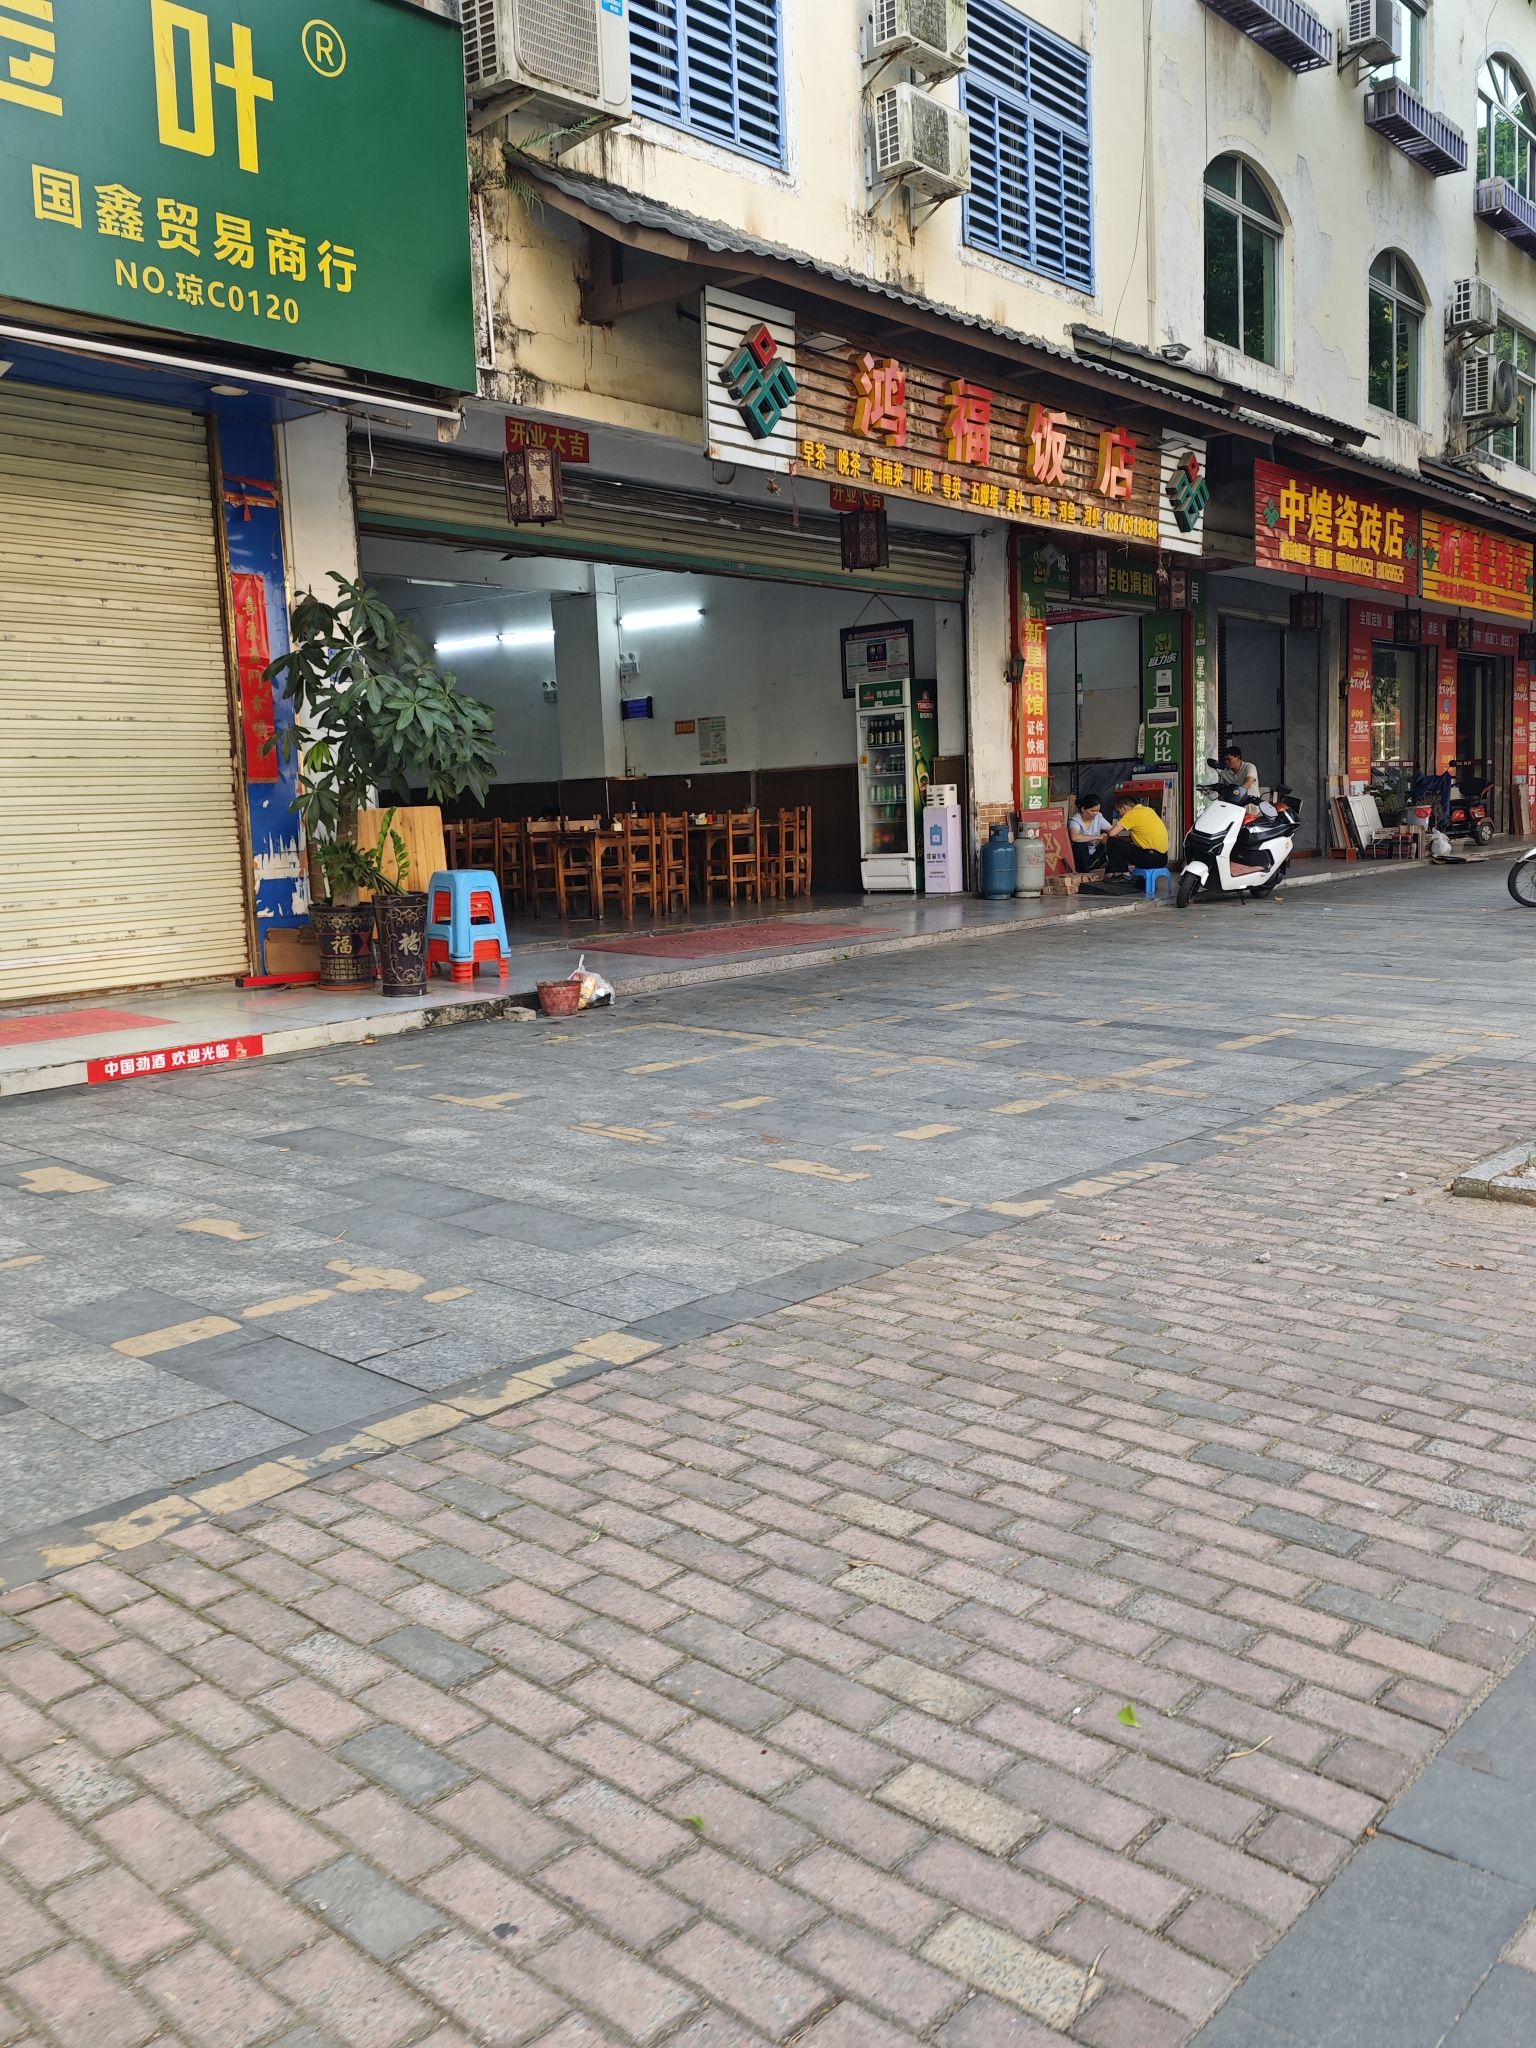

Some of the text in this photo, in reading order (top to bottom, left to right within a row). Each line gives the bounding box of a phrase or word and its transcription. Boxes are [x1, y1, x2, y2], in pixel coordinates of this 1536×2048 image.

[31, 164, 357, 293] 国鑫贸易商行
[114, 258, 300, 324] NO.琼C0120
[509, 420, 585, 458] 开业大吉
[851, 351, 1137, 501] 鸿福饭店
[801, 439, 827, 470] 早茶
[837, 448, 861, 478] 晚茶
[870, 456, 904, 488] 海南菜
[912, 467, 934, 494] 川菜
[942, 473, 962, 501] 粤菜
[1006, 488, 1025, 514] 黄牛
[1058, 500, 1076, 524] 河鱼
[1279, 479, 1405, 560] 中煌瓷砖店
[1024, 622, 1045, 716] 新星相馆
[1026, 720, 1045, 736] 证件
[1026, 739, 1045, 755] 快相
[1153, 729, 1172, 763] 价比
[330, 935, 353, 955] 福
[104, 1043, 230, 1077] 中国劲酒 欢迎光临
